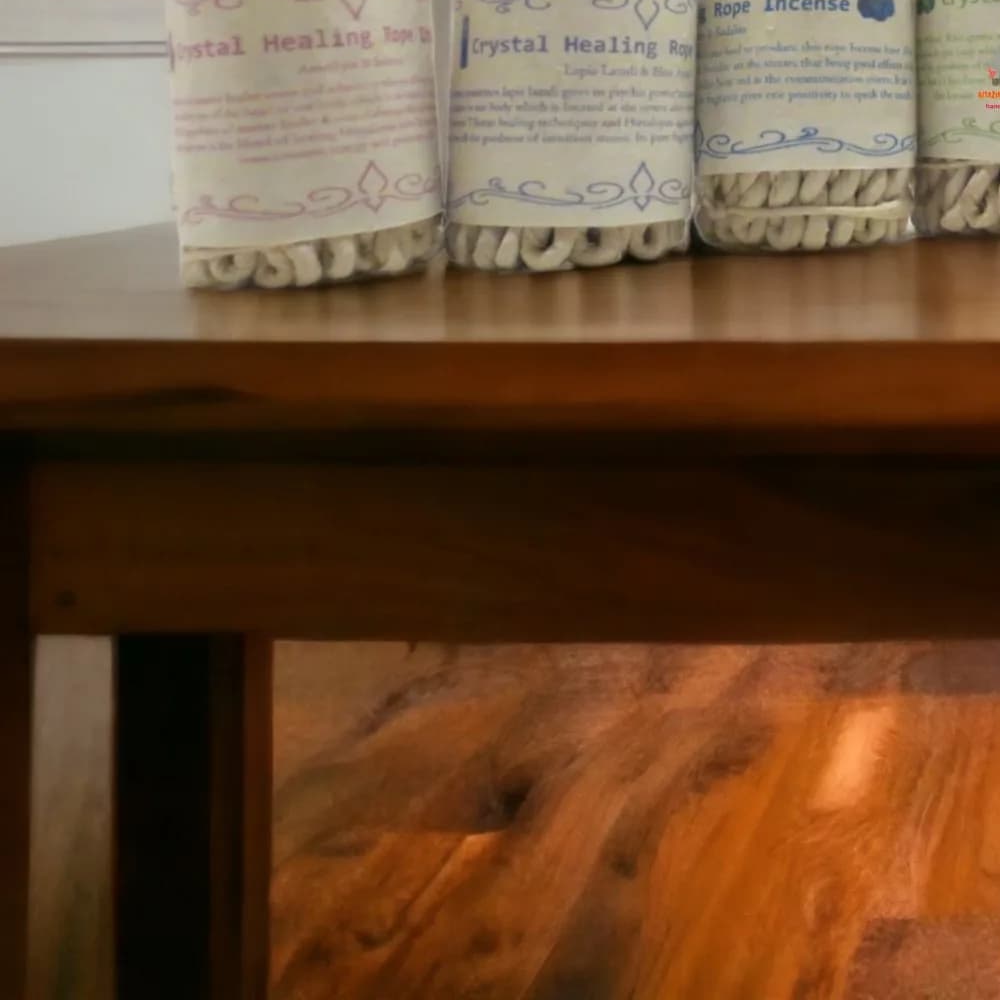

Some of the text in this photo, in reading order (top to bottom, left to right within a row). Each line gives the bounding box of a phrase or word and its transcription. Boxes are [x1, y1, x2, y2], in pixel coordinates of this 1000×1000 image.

[714, 0, 751, 19] Rope
[262, 27, 374, 55] Healing
[473, 35, 548, 57] Crystal
[564, 36, 658, 58] Healing
